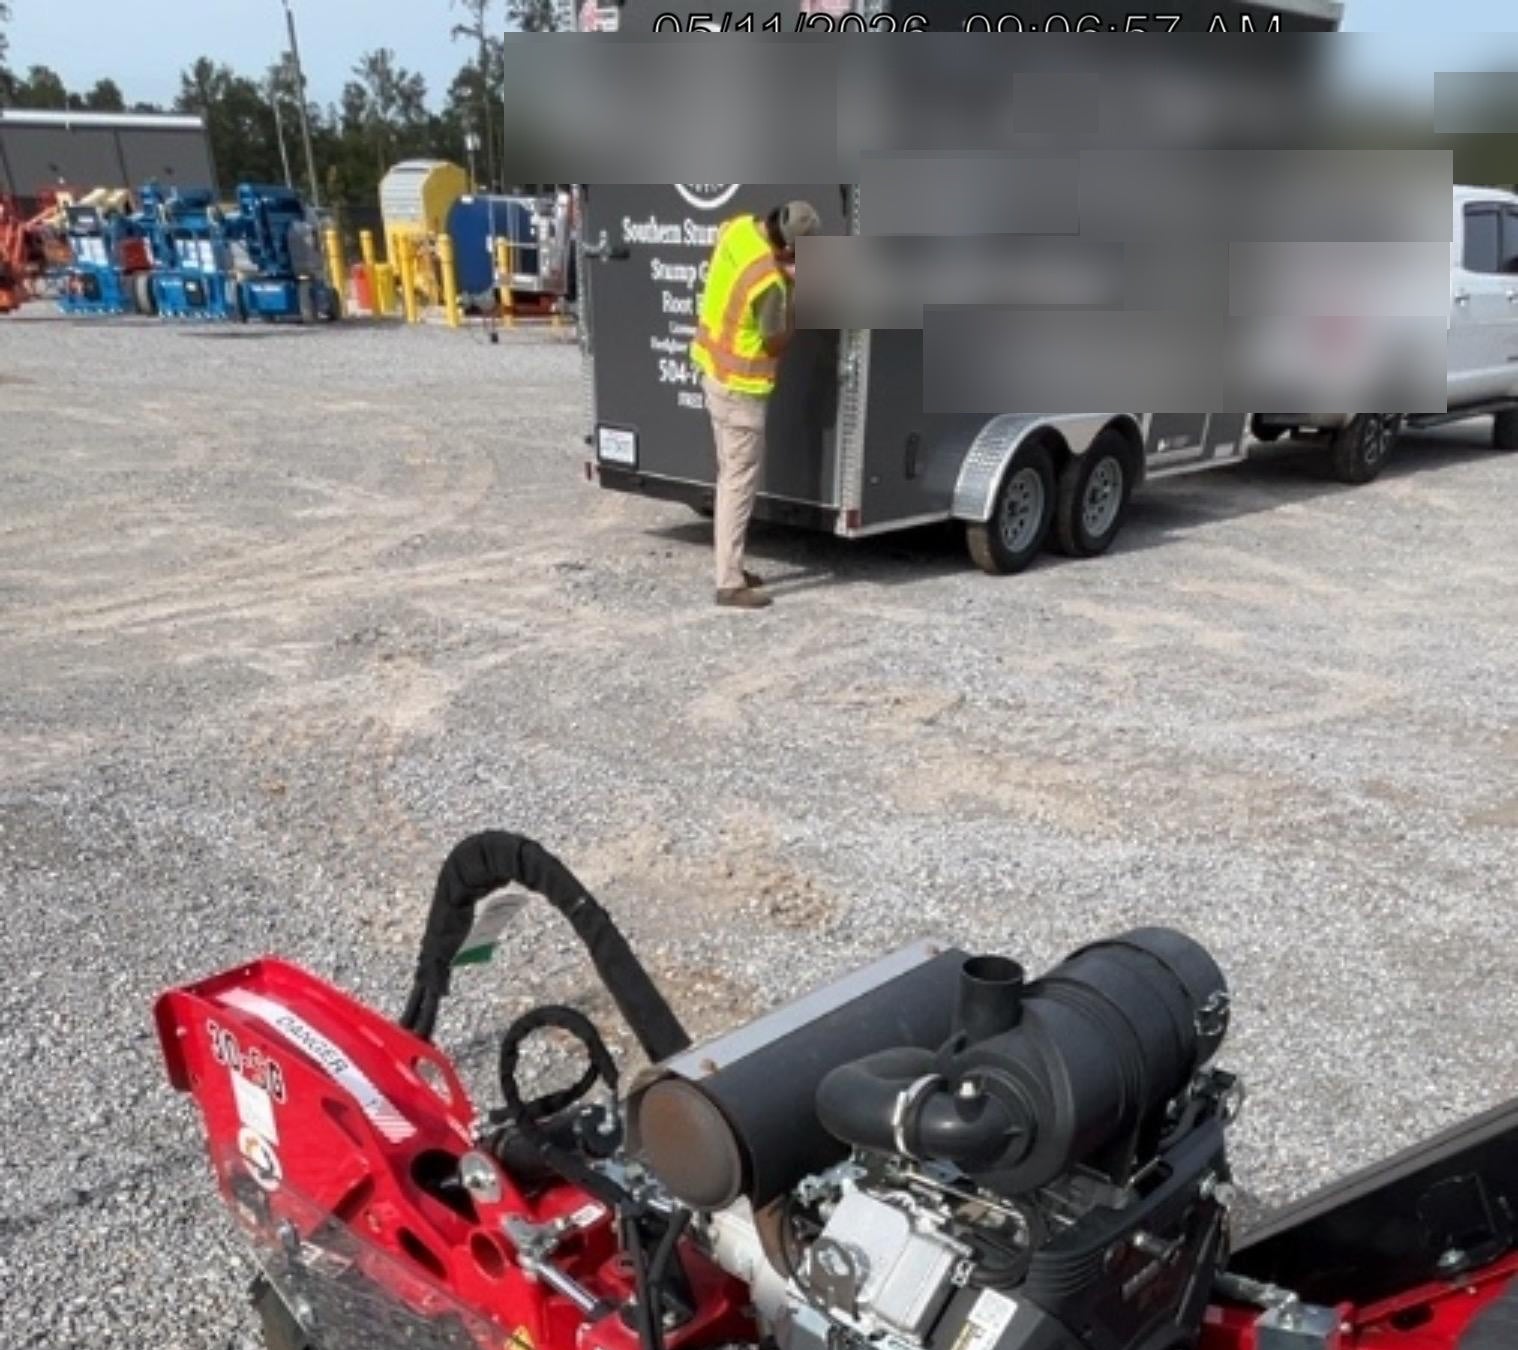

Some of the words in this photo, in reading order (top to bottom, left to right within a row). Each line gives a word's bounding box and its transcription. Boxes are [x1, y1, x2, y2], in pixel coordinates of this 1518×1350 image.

[622, 215, 682, 245] Southern
[683, 217, 719, 247] Stum
[650, 257, 697, 289] Stump
[275, 1015, 349, 1073] DANGER
